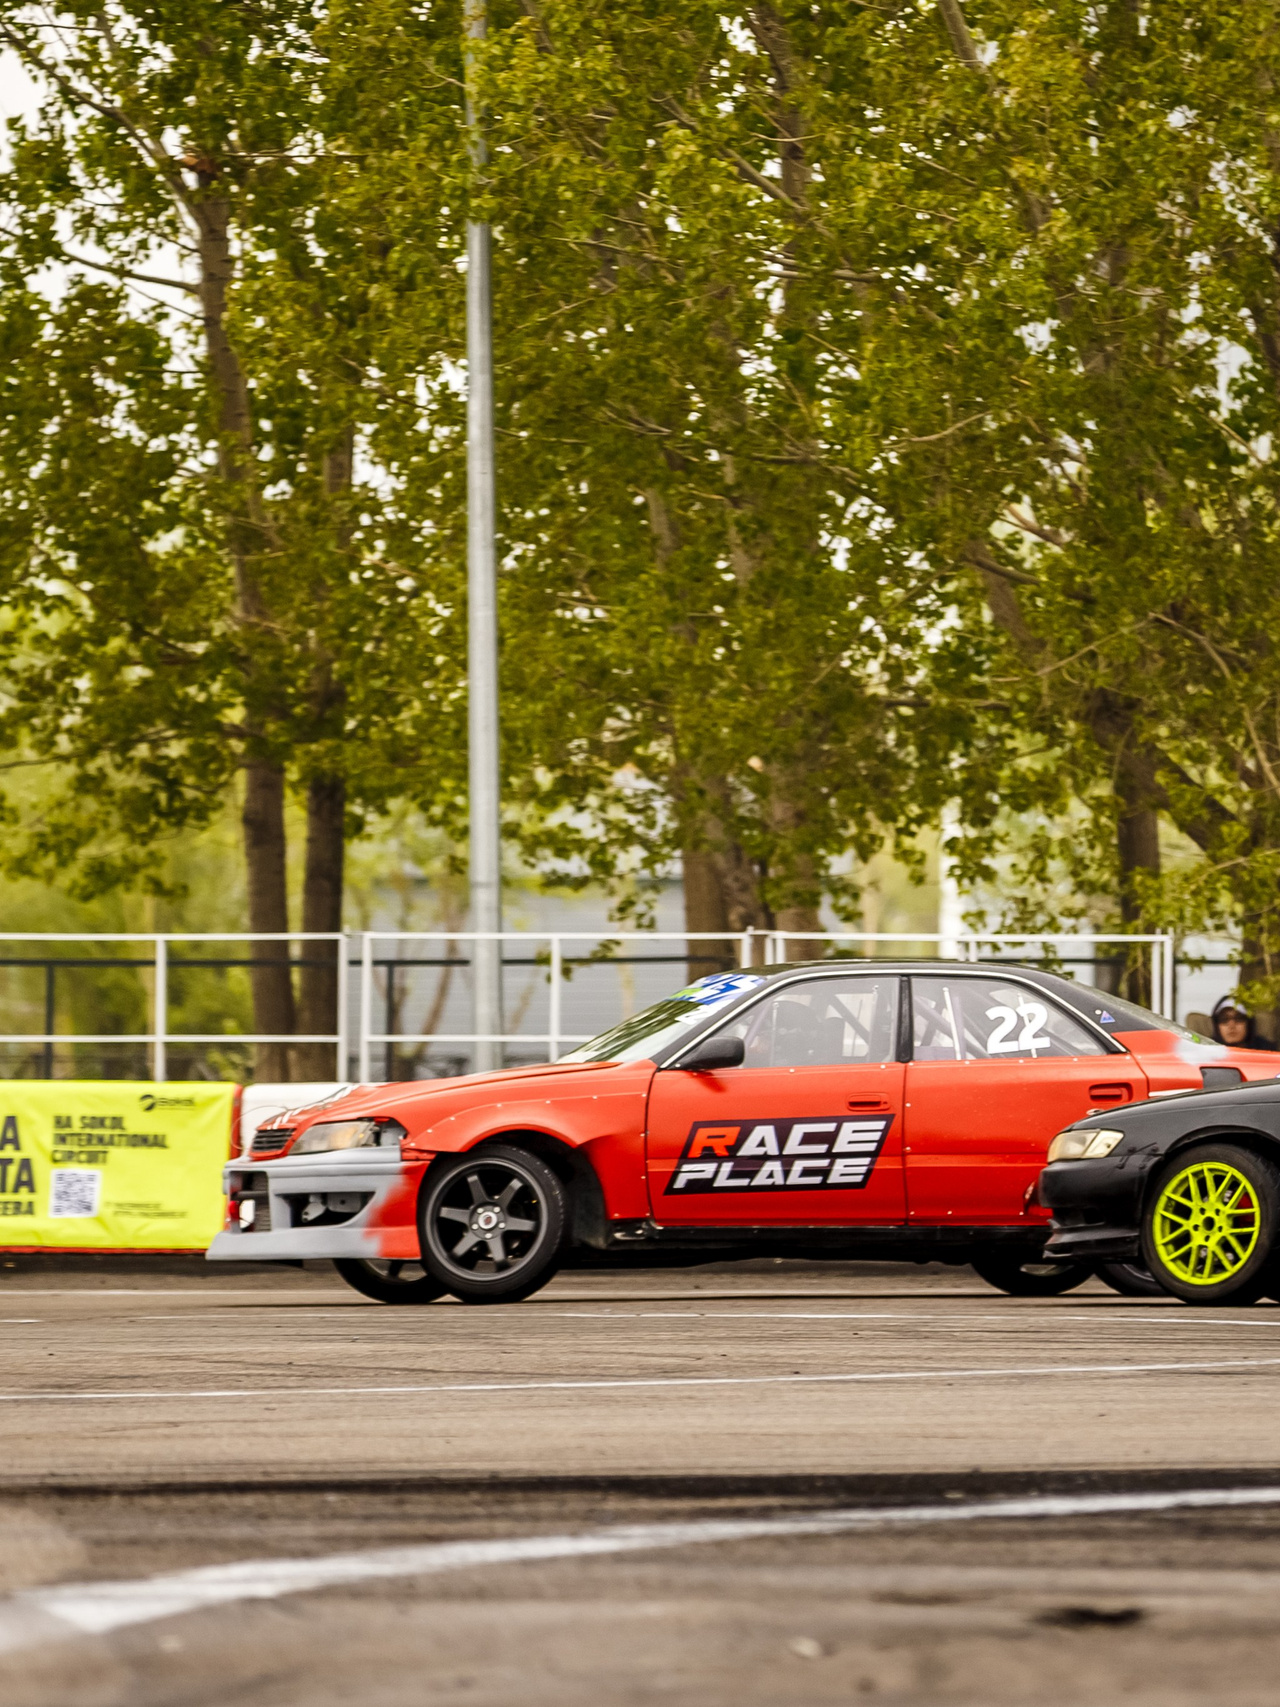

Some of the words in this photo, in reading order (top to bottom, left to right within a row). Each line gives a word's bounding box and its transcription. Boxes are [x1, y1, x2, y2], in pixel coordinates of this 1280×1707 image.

[985, 1002, 1052, 1055] 22
[79, 1115, 125, 1131] SOKOL
[54, 1132, 168, 1149] INTERNATIONAL
[688, 1120, 888, 1158] RACE
[52, 1149, 109, 1164] CIRCUIT
[673, 1157, 872, 1189] PLACE
